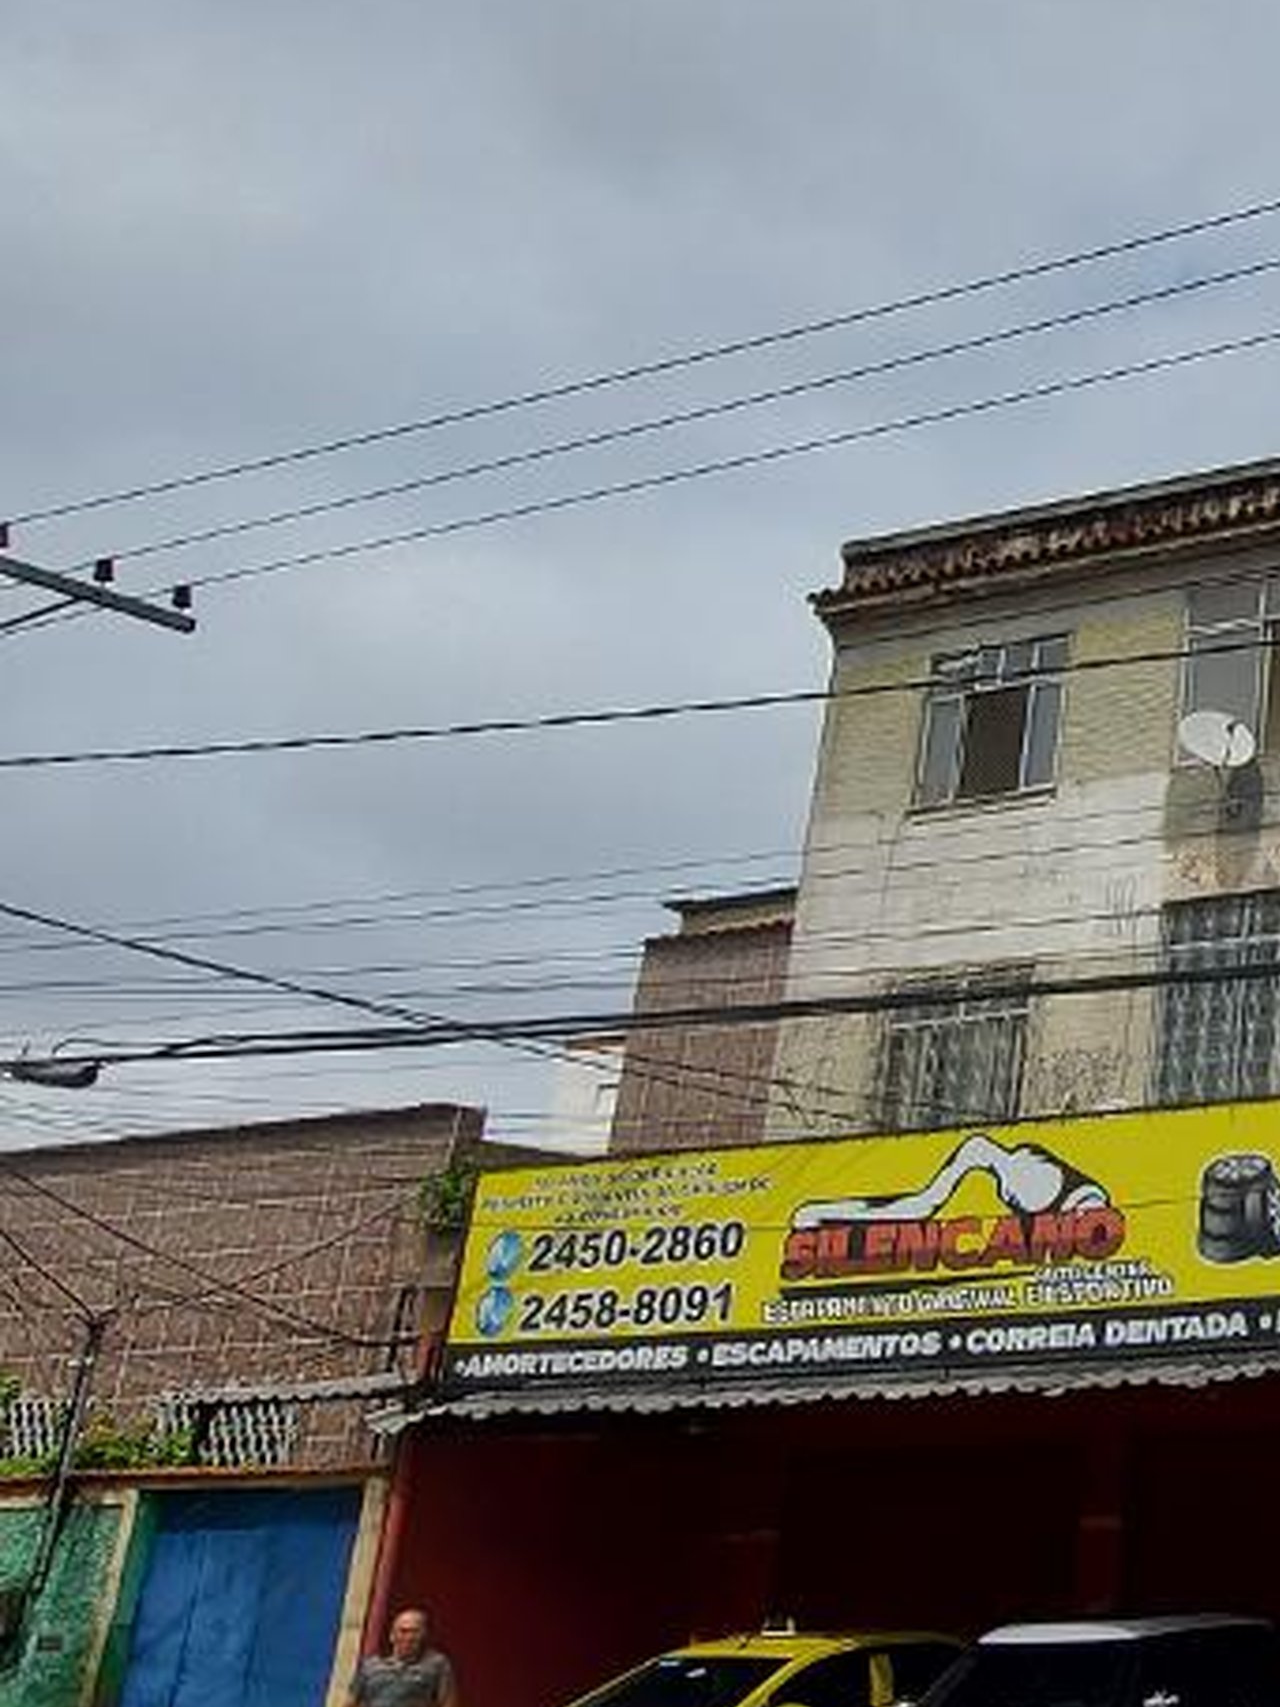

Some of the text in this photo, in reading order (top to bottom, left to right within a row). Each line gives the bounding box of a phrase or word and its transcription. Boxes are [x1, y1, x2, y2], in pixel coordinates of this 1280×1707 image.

[529, 1222, 744, 1272] 2450-2860
[781, 1207, 1126, 1278] SILENCANO
[519, 1284, 733, 1331] 2458-8091
[464, 1346, 688, 1377] AMORTECEDORES
[712, 1330, 942, 1366] ESCAPAMENTOS
[966, 1321, 1096, 1354] CORREIA
[1105, 1312, 1248, 1346] DENTADA
